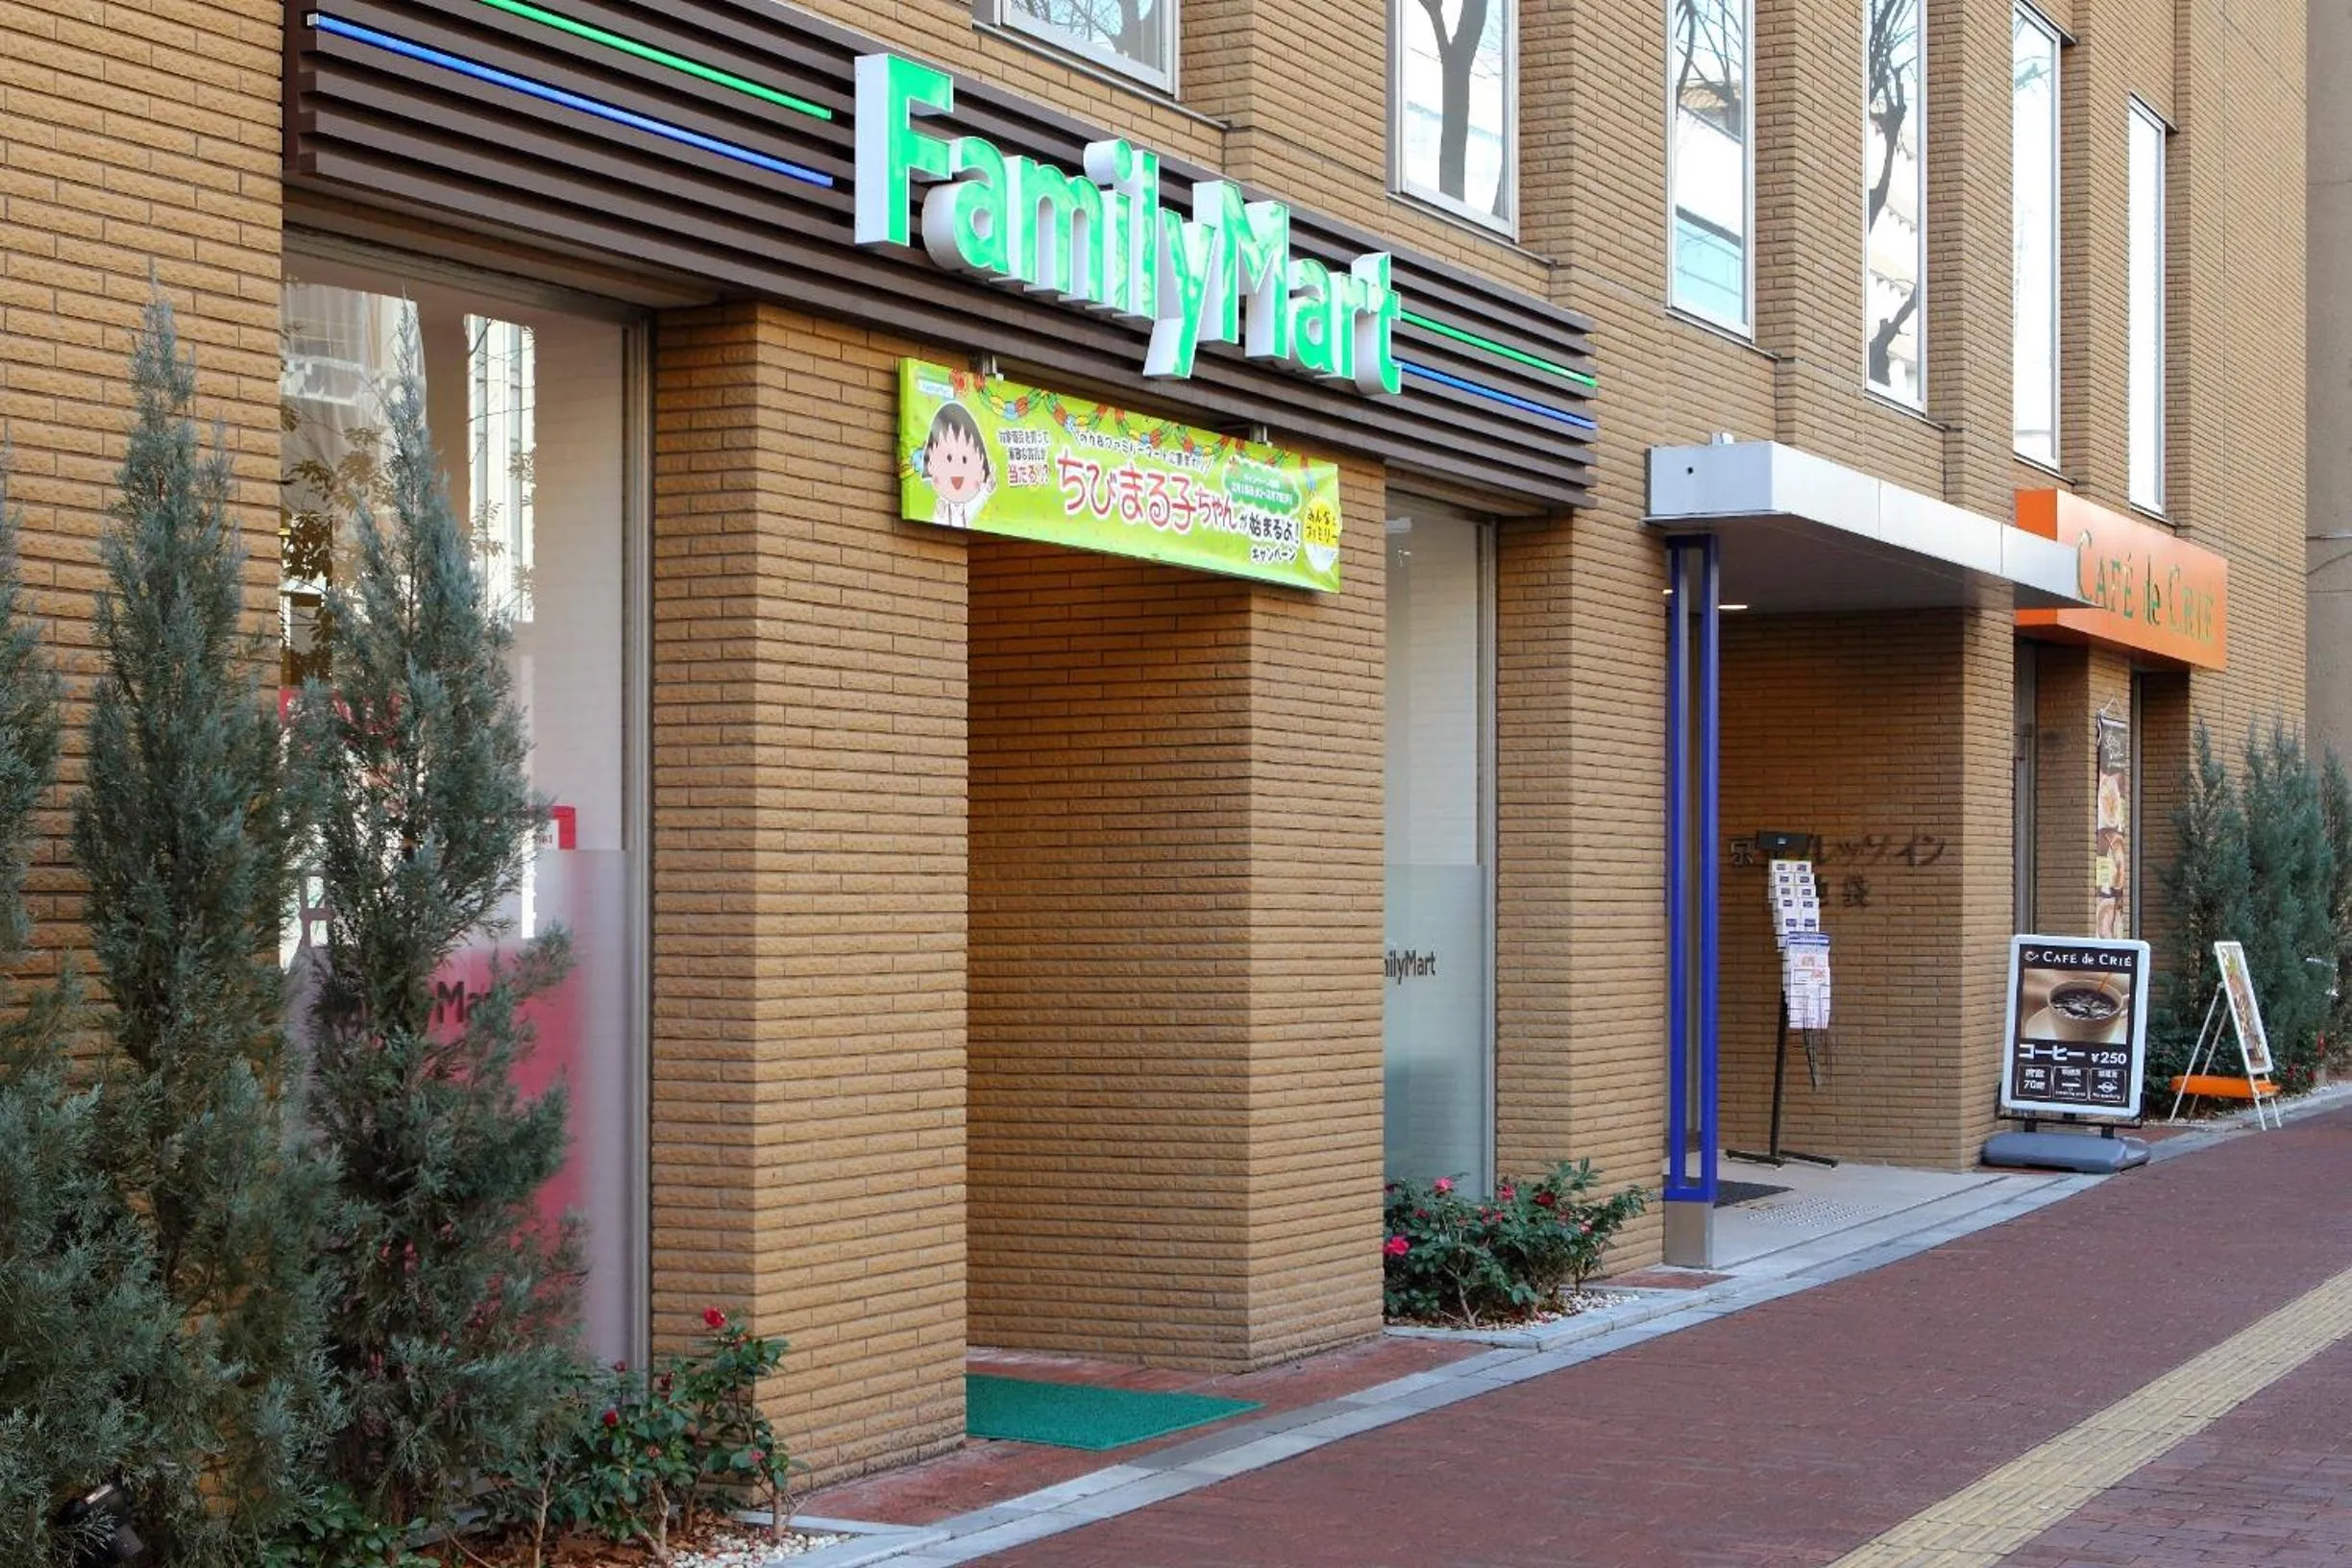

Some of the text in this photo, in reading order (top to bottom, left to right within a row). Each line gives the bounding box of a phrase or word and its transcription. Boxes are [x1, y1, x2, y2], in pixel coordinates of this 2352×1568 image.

[855, 53, 1401, 395] FamilyMart
[1057, 448, 1237, 531] ちびまる子ちゃん
[1252, 548, 1296, 562] キャンペーン
[2082, 953, 2095, 966] de
[2019, 1043, 2085, 1061] コーヒー
